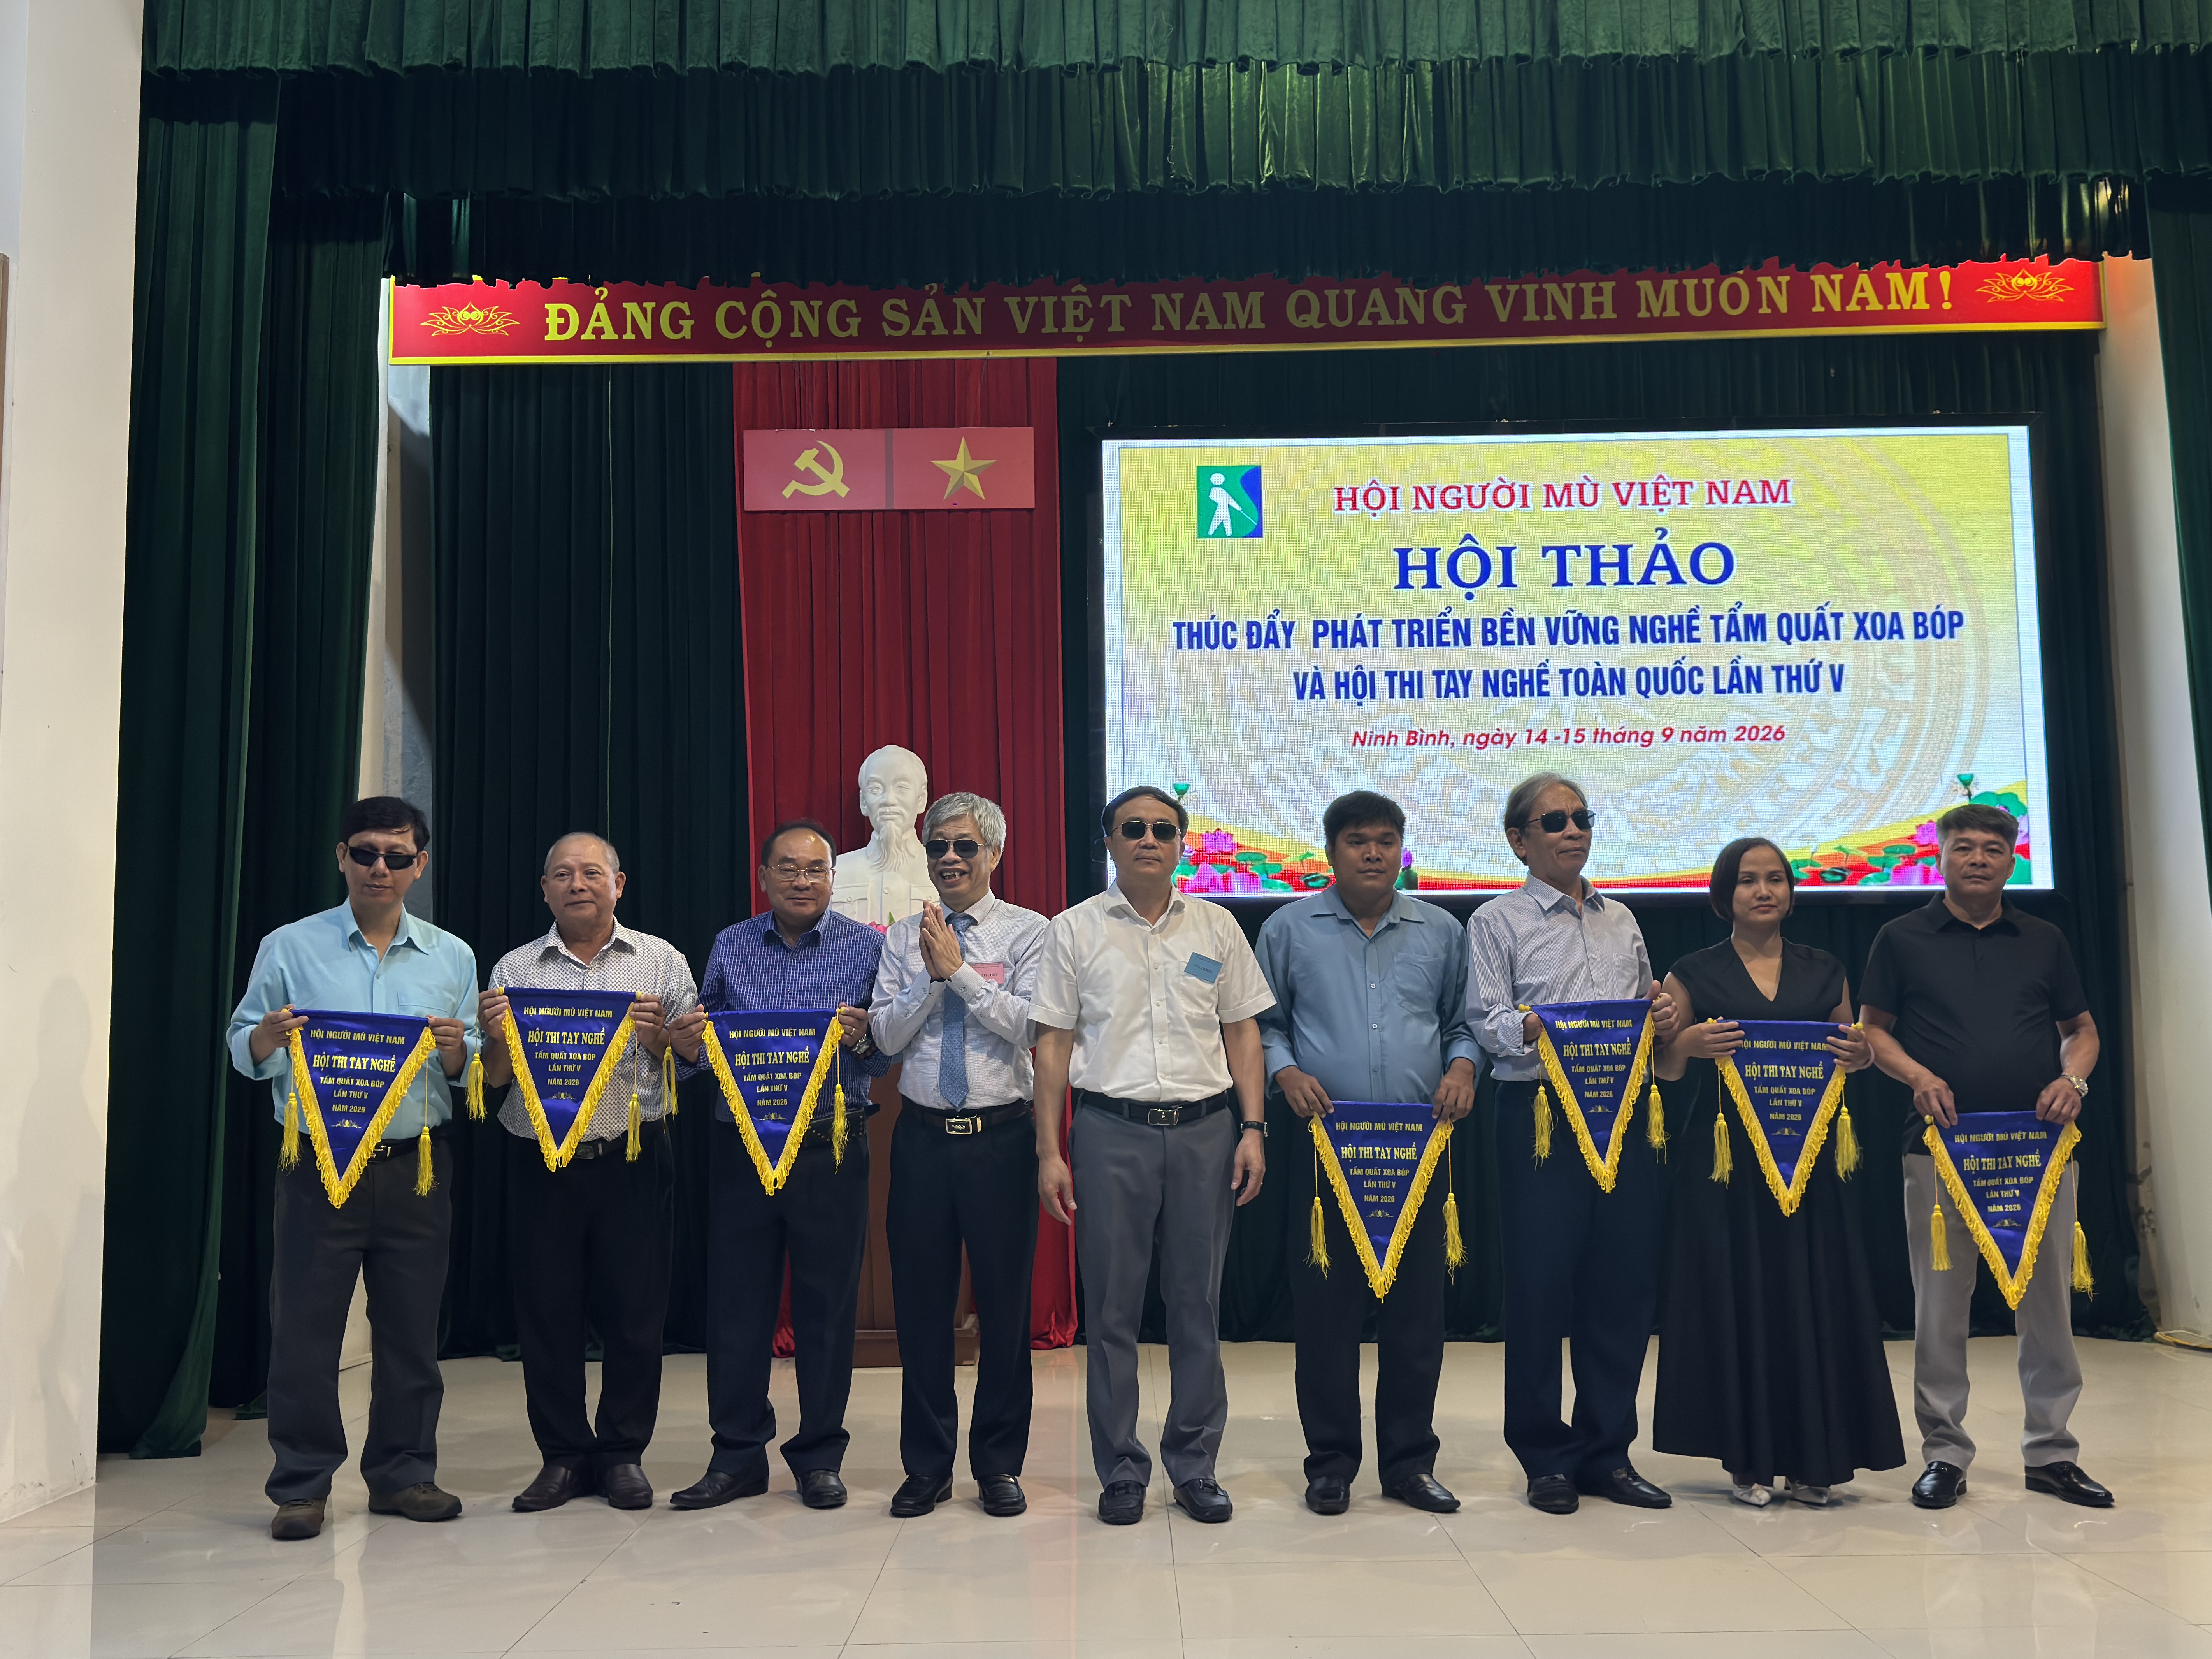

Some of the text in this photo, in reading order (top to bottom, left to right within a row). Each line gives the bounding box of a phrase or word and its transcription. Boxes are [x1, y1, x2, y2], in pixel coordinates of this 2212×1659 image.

[544, 287, 694, 340] ĐẢNG
[715, 289, 861, 348] CỘNG
[882, 283, 985, 337] SẢN
[1004, 284, 1132, 343] VIỆT
[1151, 291, 1265, 330] NAM
[1286, 285, 1466, 328] QUANG
[1485, 281, 1617, 322] VINH
[1334, 474, 1791, 517] HỘI NGƯỜI MÙ VIỆT NAM
[1393, 527, 1735, 600] HỘI THẢO
[1173, 601, 1964, 650] THÚC ĐẨY PHÁT TRIỂN BỀN VỮNG NGHỀ TẨM QUẤT XOA BÓP
[1293, 655, 1845, 706] VÀ HỘI THI TAY NGHỀ TOÀN QUỐC LẦN THỨ V
[1353, 729, 1398, 747] Ninh
[1406, 728, 1455, 749] Bình,
[1463, 729, 1516, 750] ngày
[1592, 727, 1653, 746] tháng
[1661, 727, 1673, 743] 9
[1680, 727, 1727, 742] năm
[1734, 726, 1785, 742] 2026
[524, 1007, 537, 1016] HỘI
[539, 1006, 562, 1016] NGƯỜI
[564, 1008, 576, 1016] MÙ
[578, 1008, 593, 1018] VIỆT
[311, 1029, 405, 1044] HỘI NGƯỜI MÙ VIỆT NAM
[528, 1027, 605, 1046] HỘI THI TAY NGHỀ
[729, 1030, 741, 1039] HỘI
[743, 1028, 766, 1037] NGƯỜI
[768, 1028, 779, 1036] MÙ
[781, 1028, 797, 1037] VIỆT
[313, 1052, 396, 1072] HỘI THI TAY NGHỀ
[735, 1046, 809, 1069] HỘI THI TAY NGHỀ
[332, 1104, 348, 1112] NĂM
[1341, 1142, 1417, 1162] HỘI THI TAY NGHỀ
